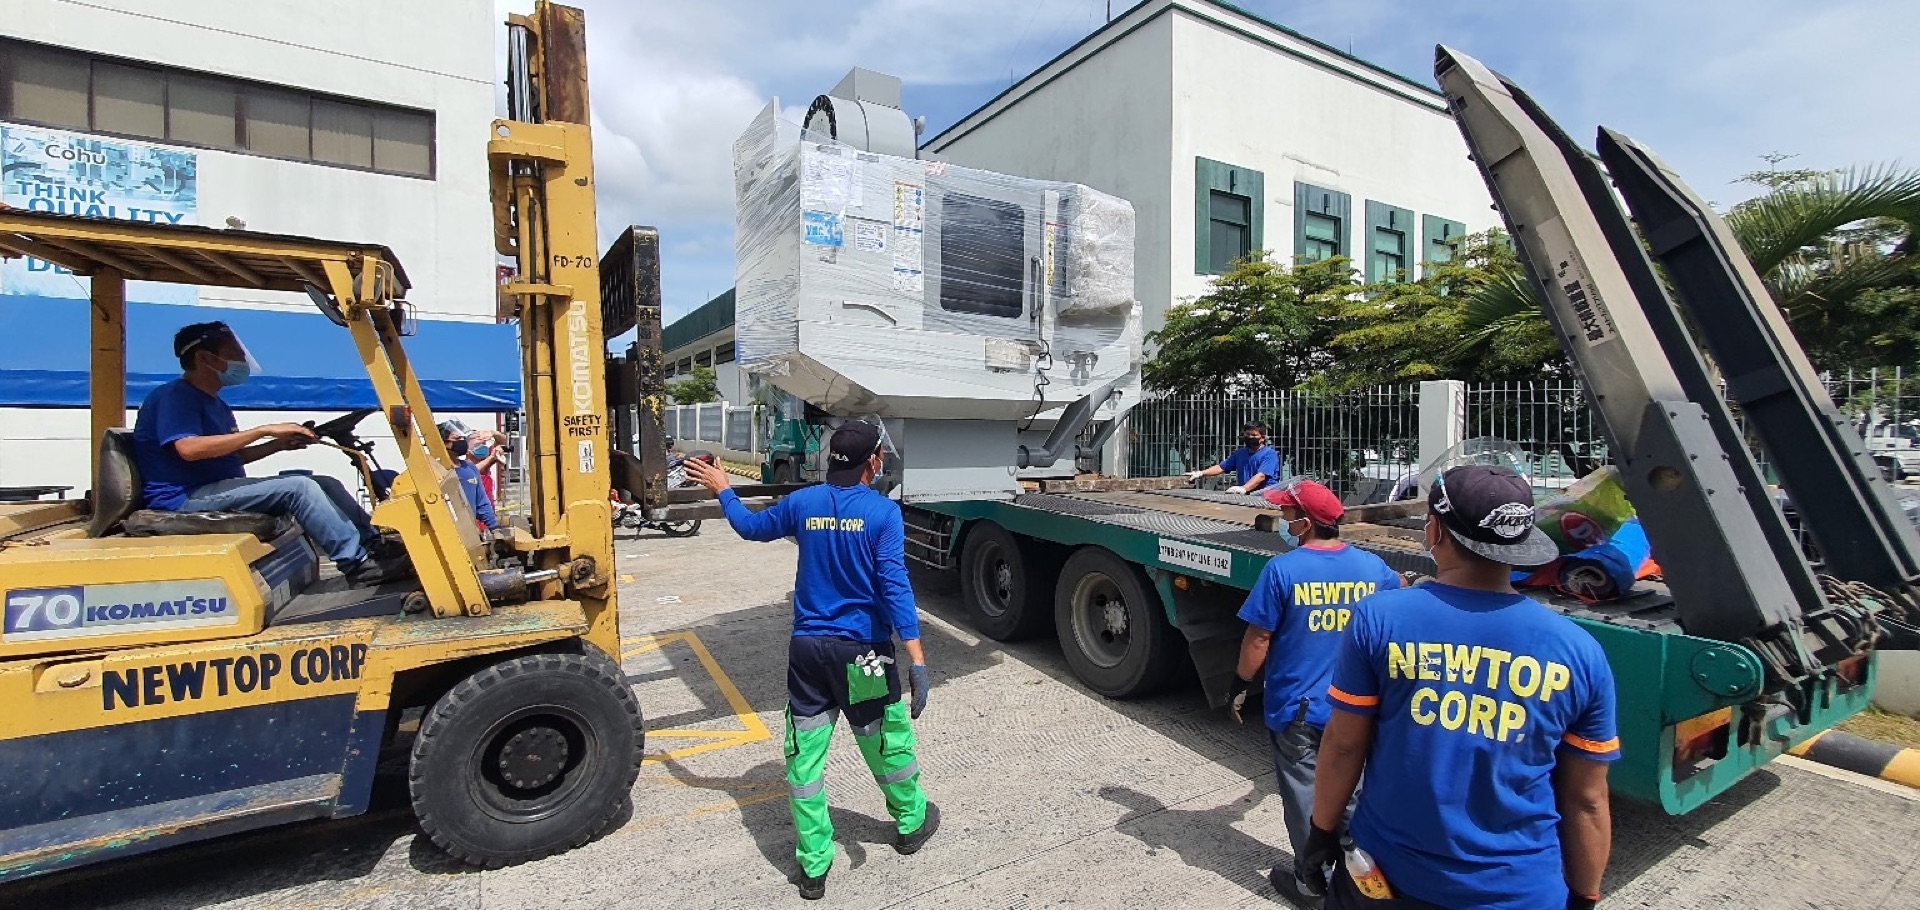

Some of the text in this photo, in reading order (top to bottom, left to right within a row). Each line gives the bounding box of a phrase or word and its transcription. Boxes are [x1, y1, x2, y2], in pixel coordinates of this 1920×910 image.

[45, 144, 106, 165] Cohu
[15, 180, 106, 204] THINK
[553, 255, 592, 269] FD-70
[569, 300, 592, 416] KOMATSU
[563, 414, 602, 428] SAFETY
[568, 425, 601, 438] FIRST
[9, 594, 227, 630] 70 KOMATSU
[290, 643, 369, 686] CORP
[1388, 641, 1571, 702] NEWTOP
